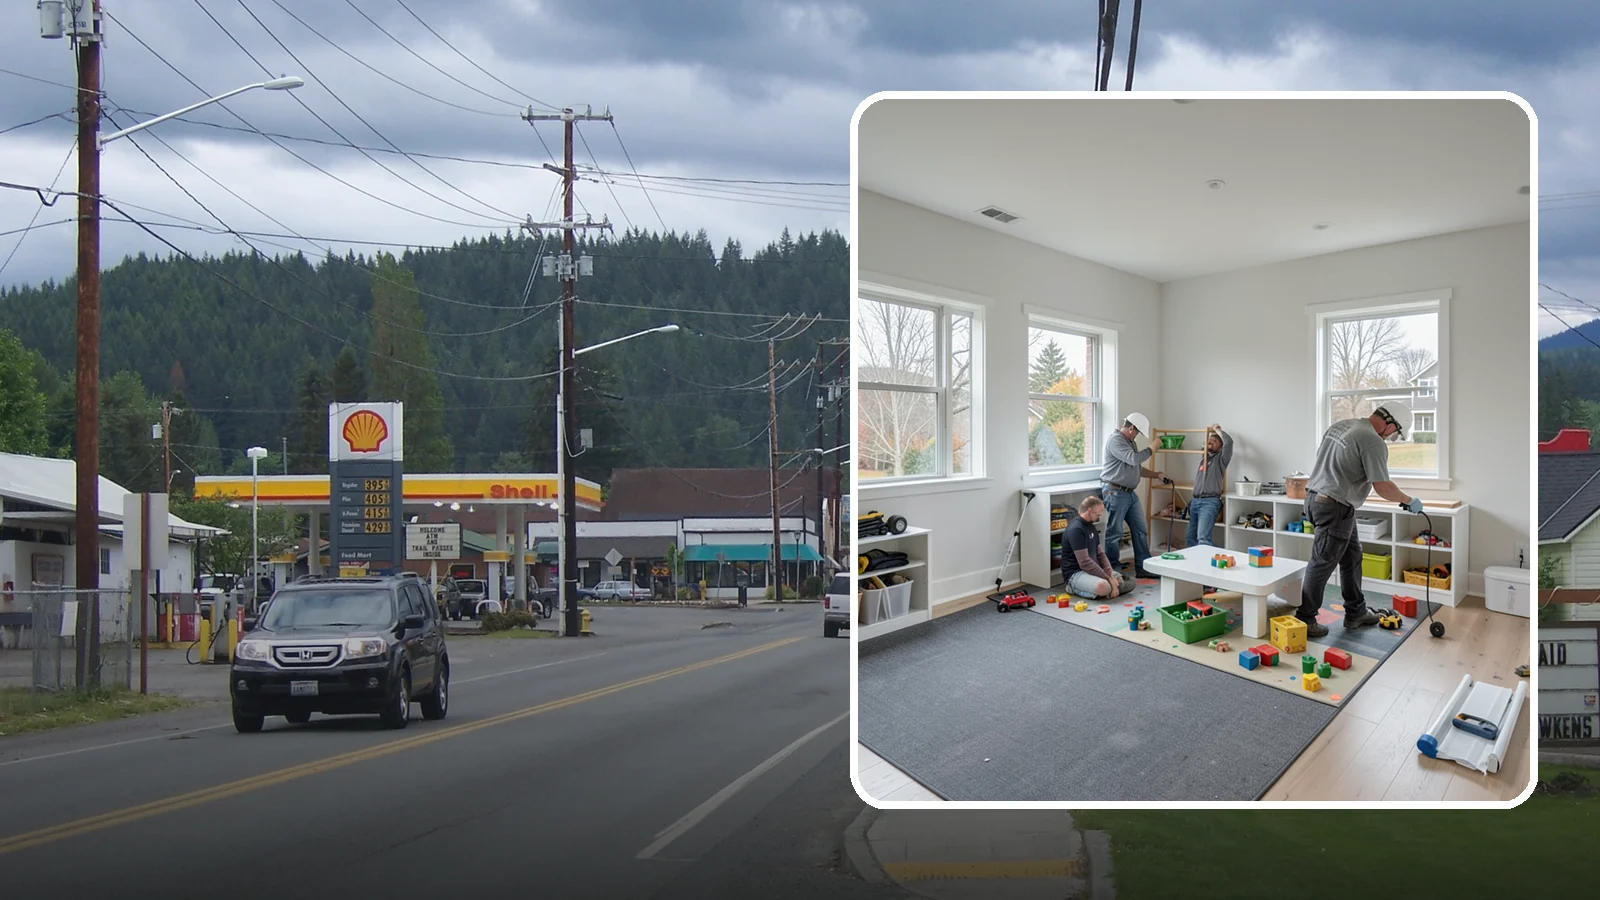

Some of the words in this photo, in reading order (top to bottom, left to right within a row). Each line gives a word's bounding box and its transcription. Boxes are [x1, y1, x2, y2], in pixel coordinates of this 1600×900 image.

[366, 480, 383, 490] 395
[490, 484, 547, 498] Shell
[366, 494, 383, 504] 405
[366, 508, 383, 518] 415
[366, 522, 383, 532] 429
